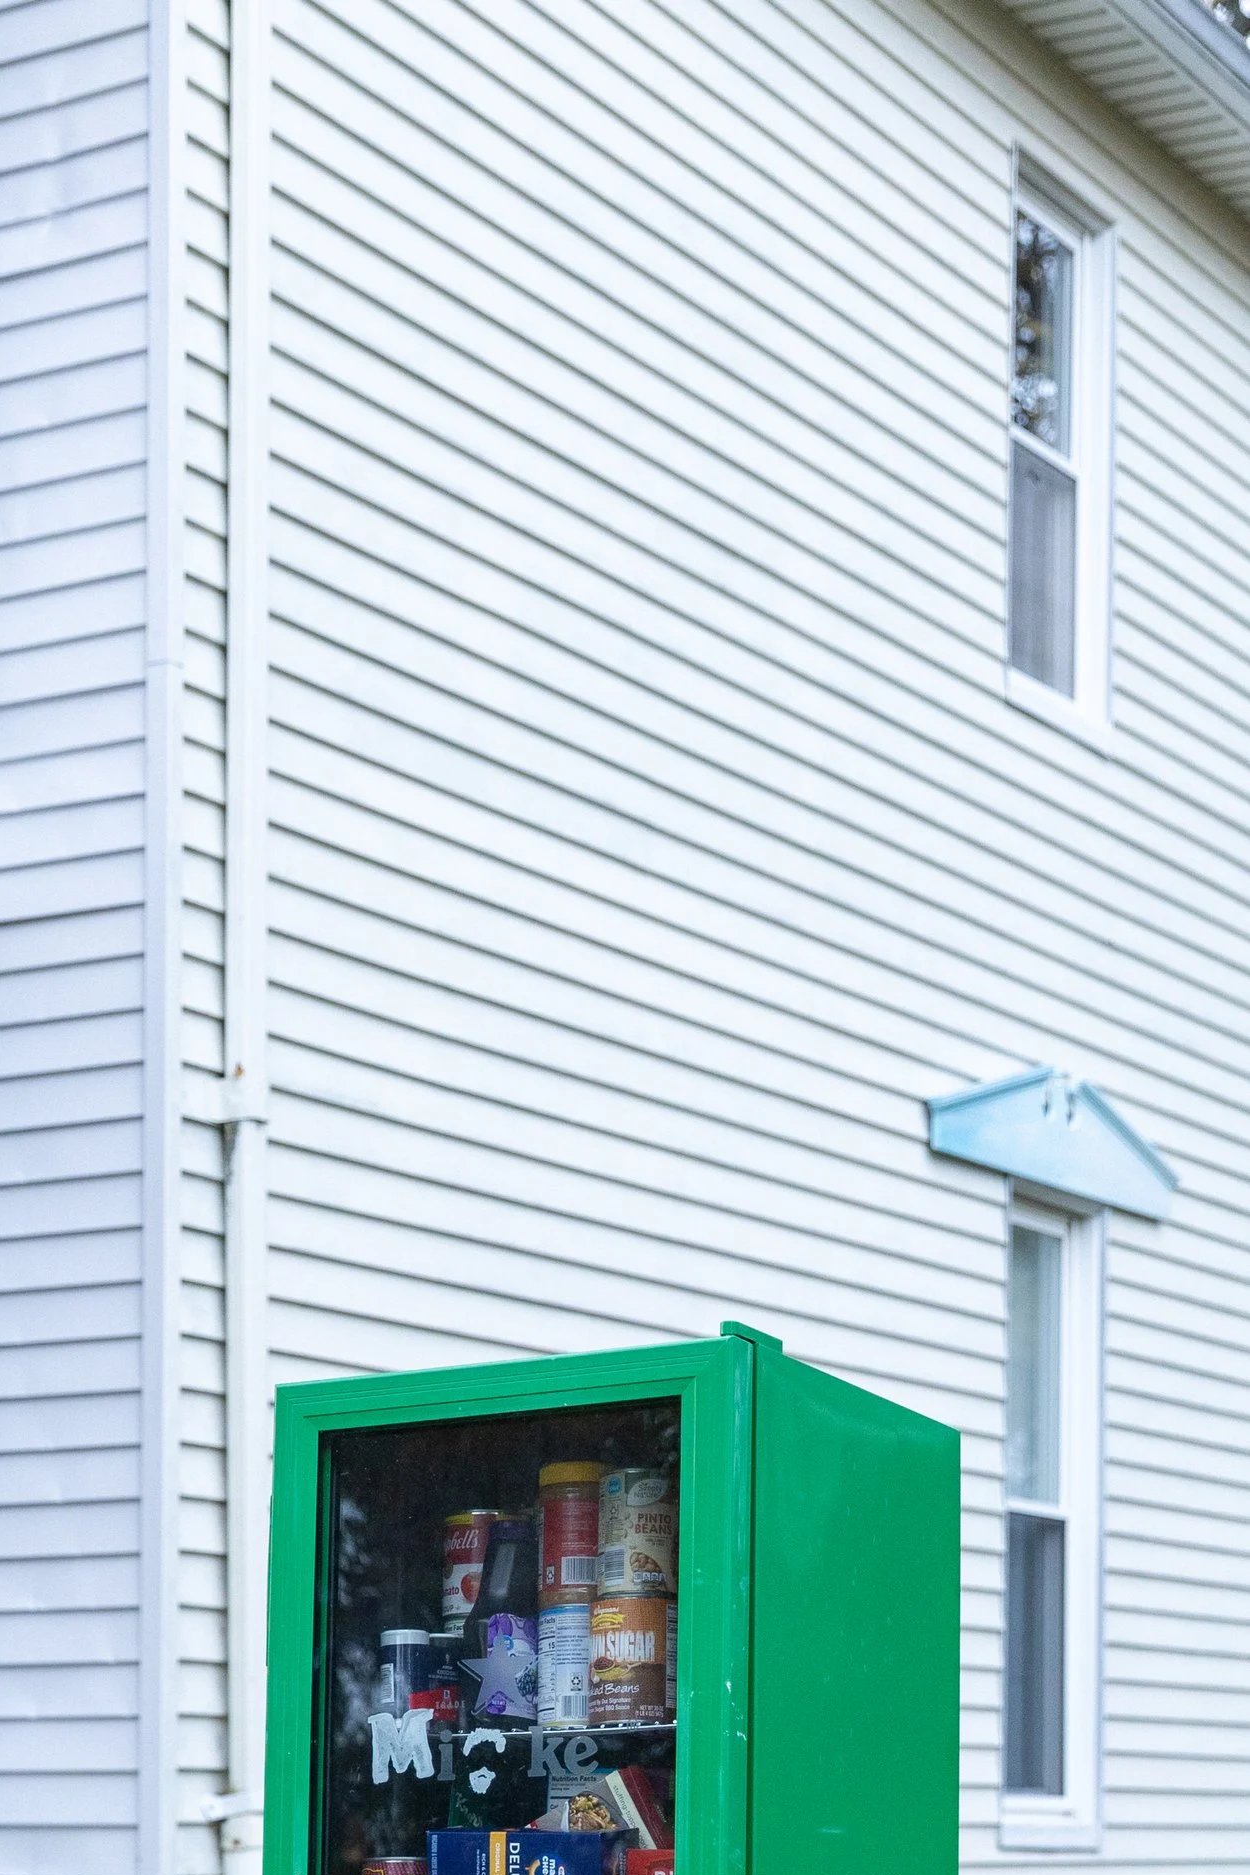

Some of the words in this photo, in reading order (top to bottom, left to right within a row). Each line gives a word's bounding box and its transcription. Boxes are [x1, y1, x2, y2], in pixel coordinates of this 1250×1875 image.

[637, 1512, 672, 1524] PINTO
[634, 1523, 672, 1535] BEANS
[605, 1630, 655, 1662] SUGAR
[604, 1682, 640, 1696] Beans
